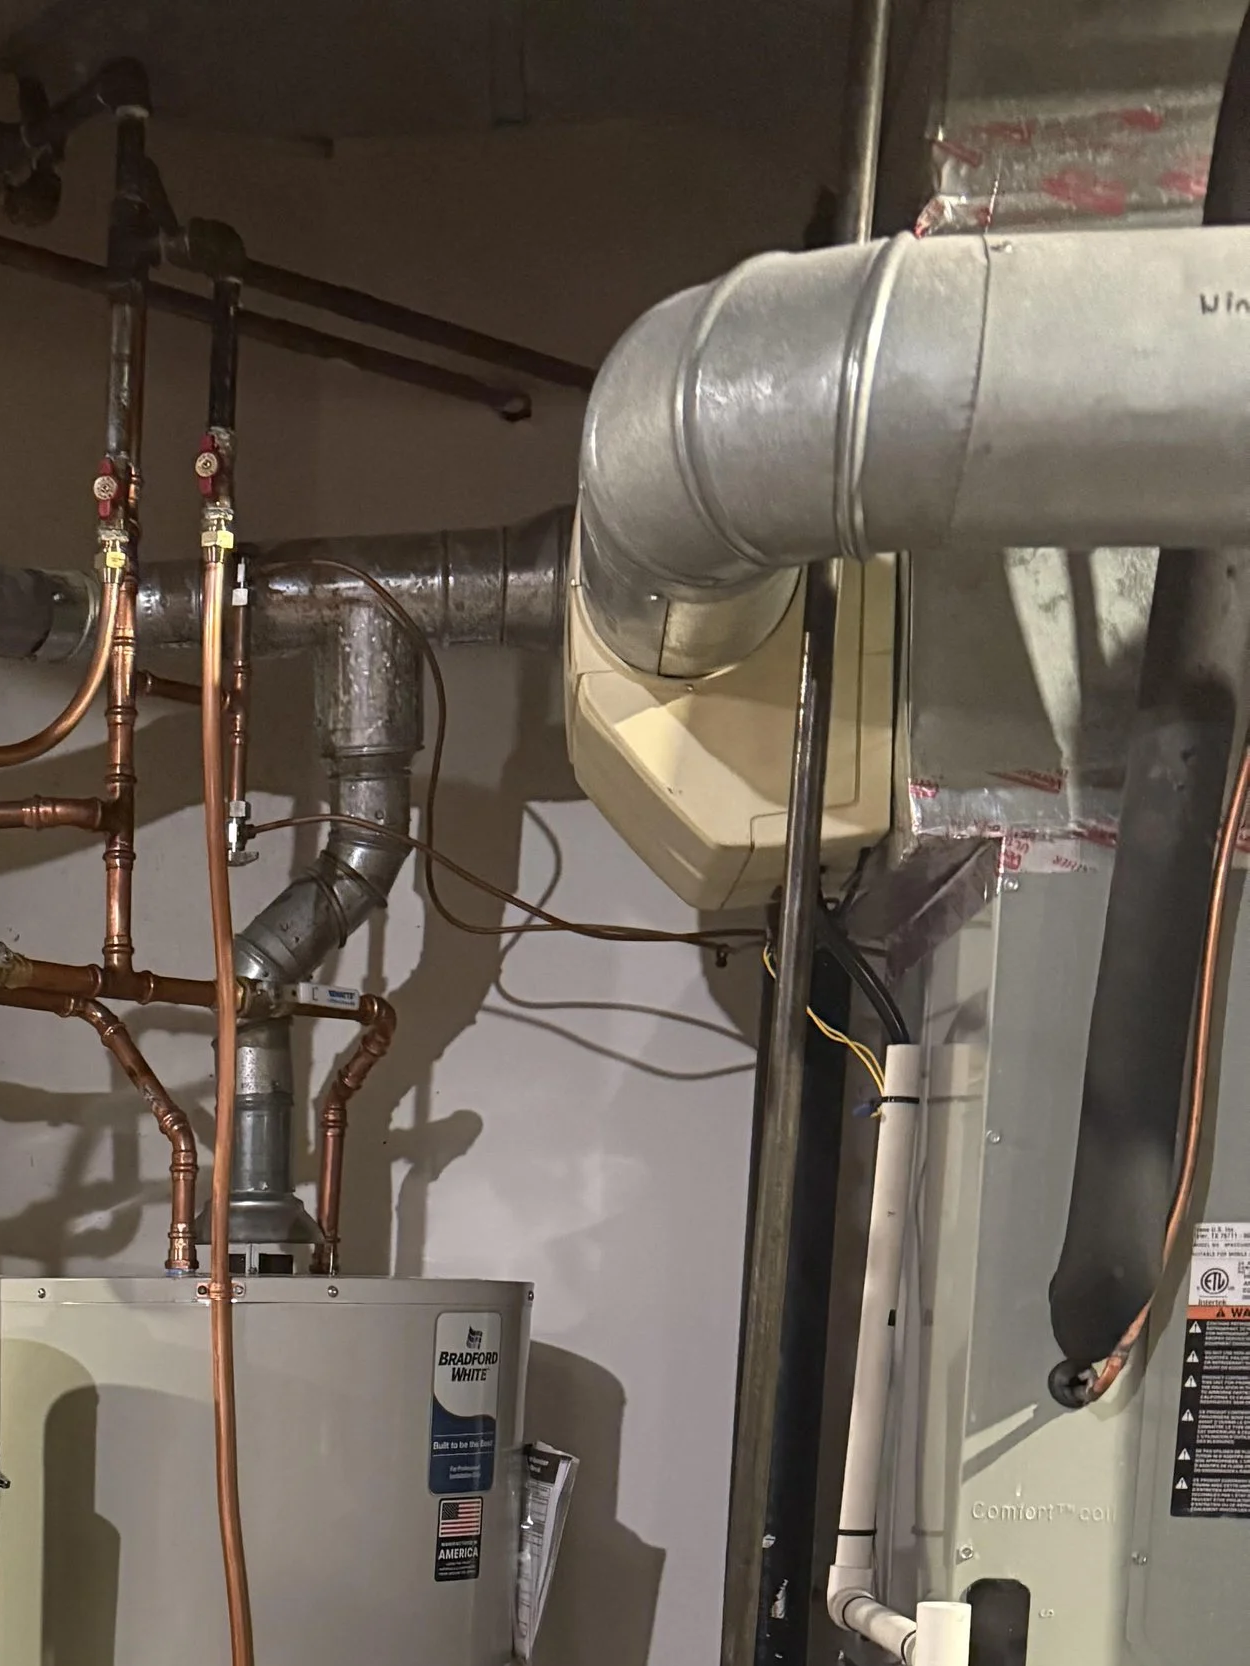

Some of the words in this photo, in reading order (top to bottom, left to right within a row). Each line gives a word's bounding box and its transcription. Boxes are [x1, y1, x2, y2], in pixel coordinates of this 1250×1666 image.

[1205, 1272, 1225, 1291] ETL
[438, 1352, 498, 1365] BRADFORD
[452, 1367, 487, 1382] WHITE
[433, 1441, 449, 1450] Built
[451, 1441, 458, 1449] to
[438, 1546, 478, 1560] AMERICA
